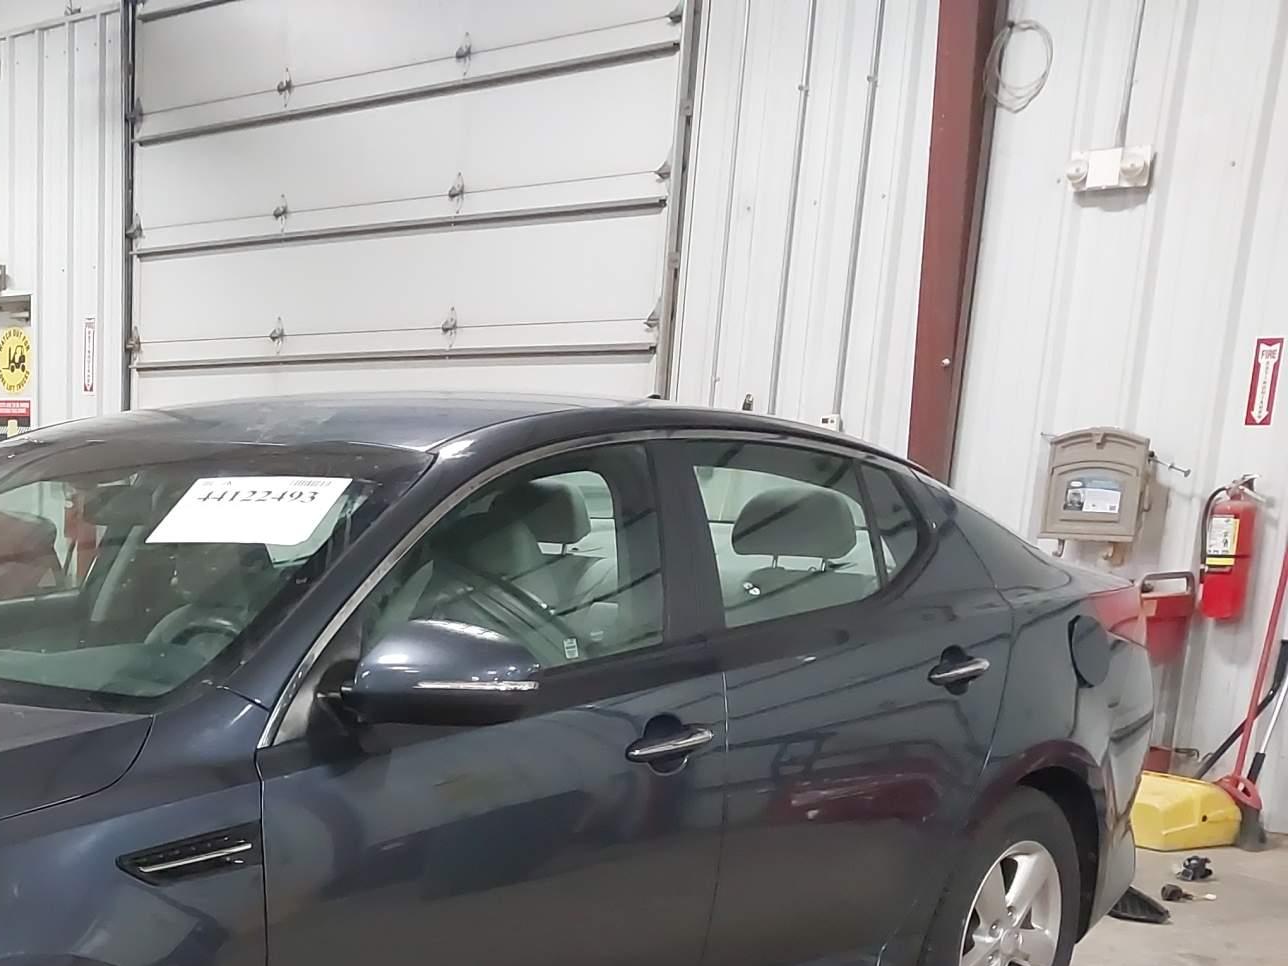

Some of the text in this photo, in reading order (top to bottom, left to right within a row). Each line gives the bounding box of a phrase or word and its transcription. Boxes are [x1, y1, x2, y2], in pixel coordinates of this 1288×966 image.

[13, 328, 23, 338] OUT
[22, 335, 31, 352] FOR
[1261, 350, 1277, 360] FIRE
[197, 490, 319, 504] 44122493
